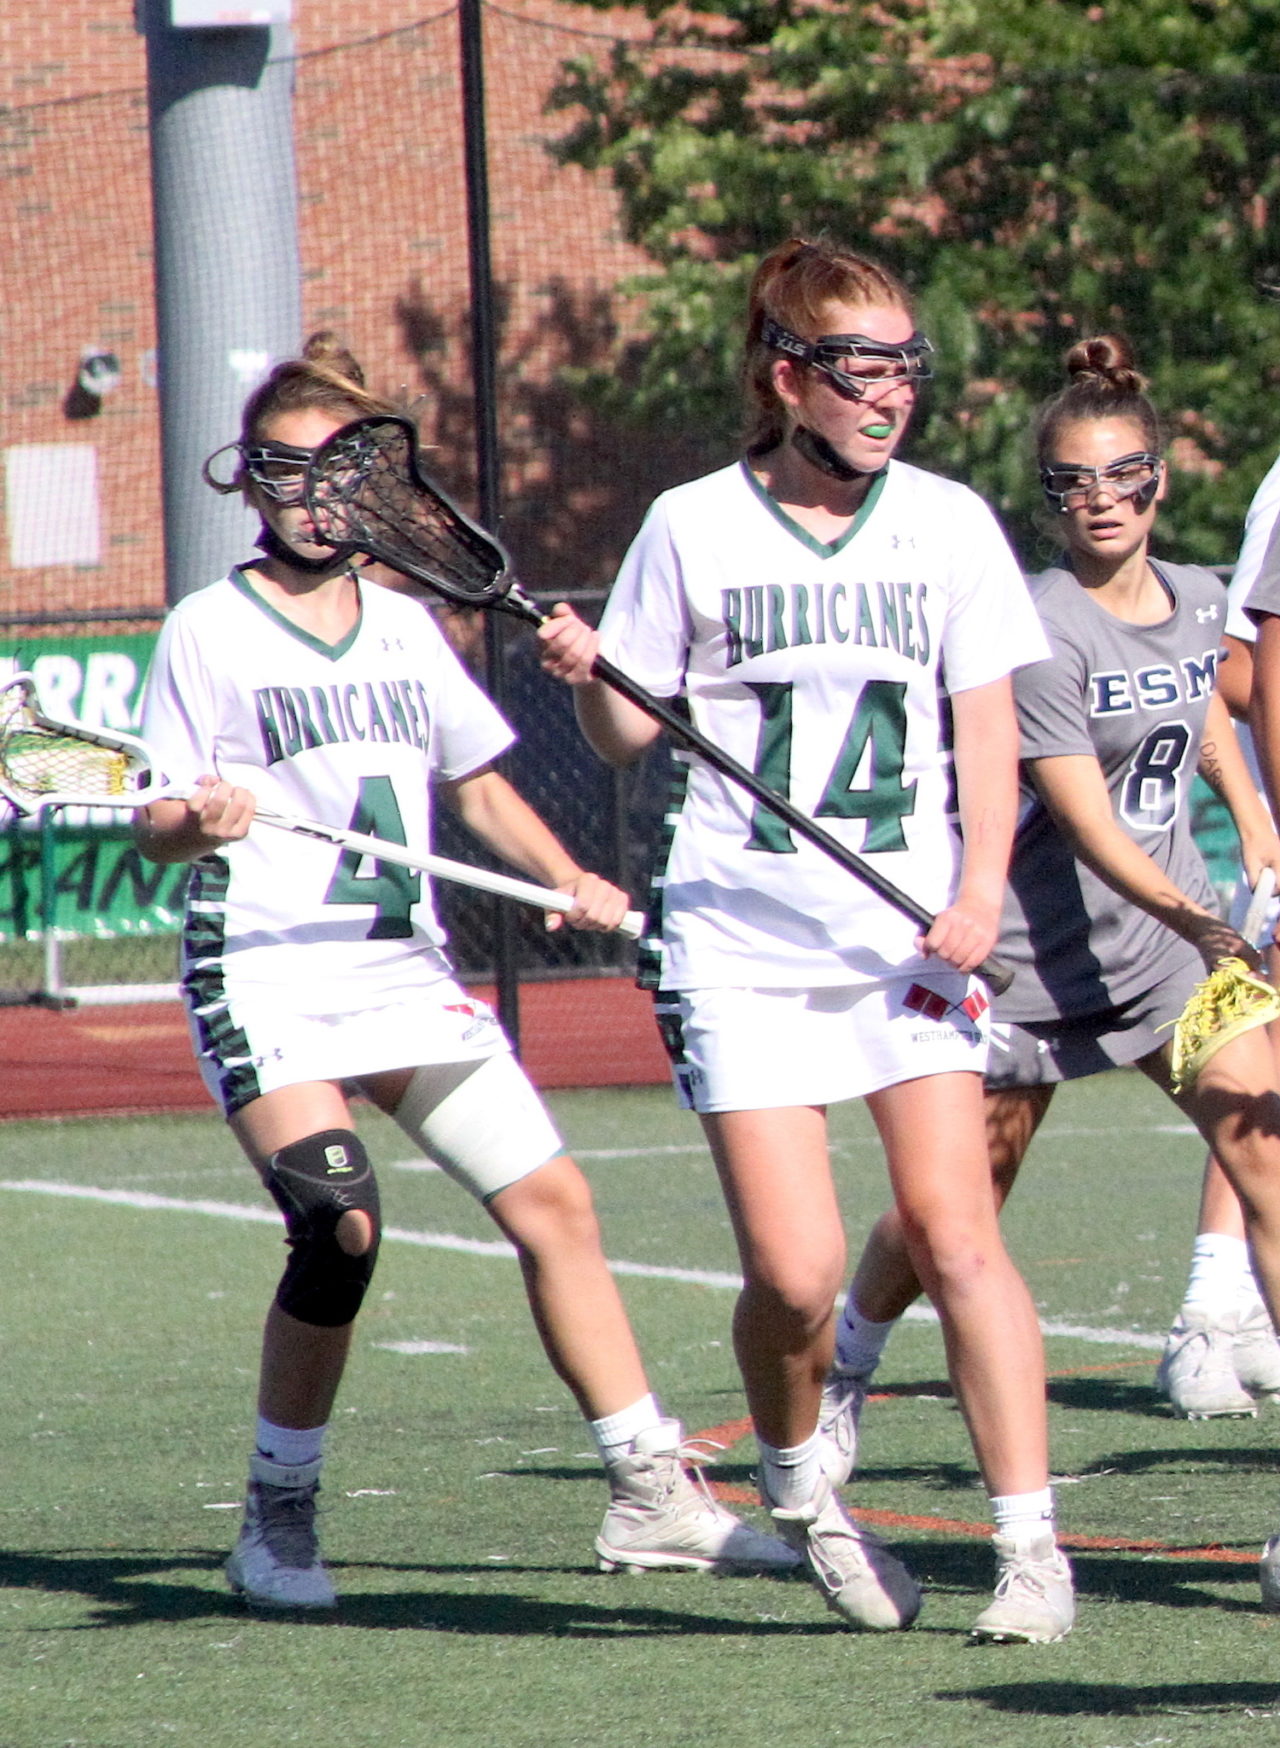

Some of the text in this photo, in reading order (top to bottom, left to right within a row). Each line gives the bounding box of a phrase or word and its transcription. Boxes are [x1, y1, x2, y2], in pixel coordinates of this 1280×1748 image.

[720, 581, 931, 670] HURRICANES
[251, 679, 431, 768] HURRICANES
[1090, 648, 1217, 718] ESM
[741, 680, 917, 853] 14
[1119, 719, 1193, 832] 8
[321, 774, 422, 940] 4
